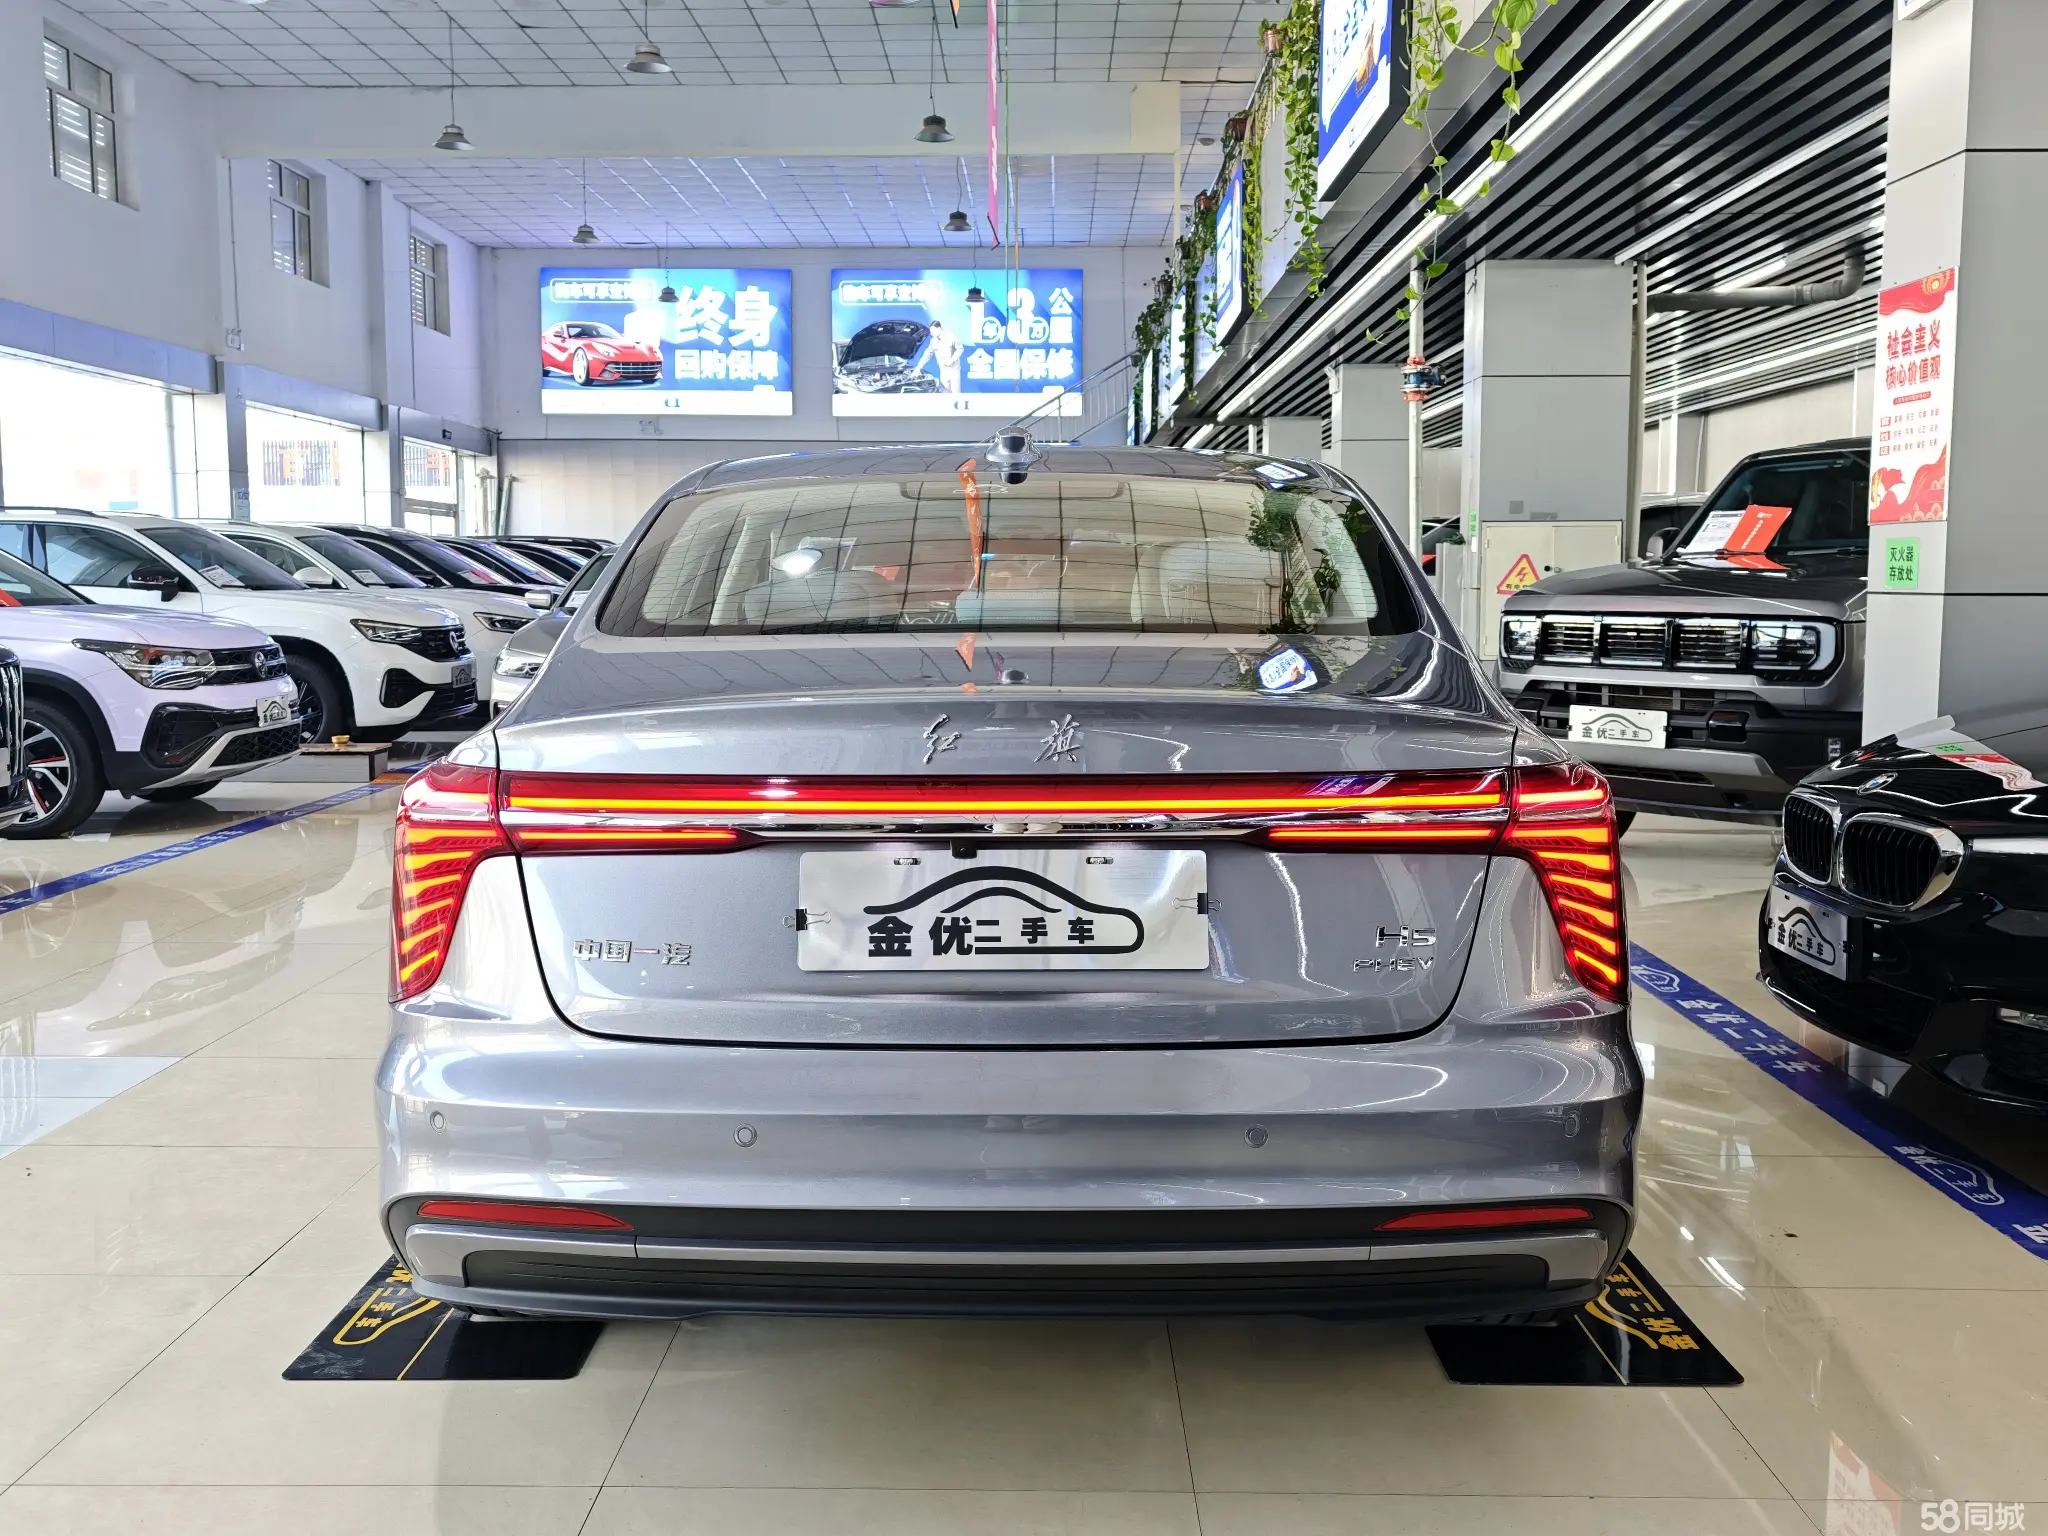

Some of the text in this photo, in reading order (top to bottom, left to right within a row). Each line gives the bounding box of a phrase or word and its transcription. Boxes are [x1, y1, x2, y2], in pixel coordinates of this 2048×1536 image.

[675, 285, 779, 347] 终身
[1886, 319, 1941, 361] 社会主义
[1885, 355, 1941, 390] 核心价值观
[1890, 545, 1914, 562] 灭火器
[1889, 565, 1914, 582] 存放处
[923, 713, 1082, 764] 红旗
[1581, 725, 1640, 739] 金优二手车
[572, 938, 692, 966] 中国一汽
[867, 915, 1095, 958] 金优二手车
[1375, 925, 1437, 948] H5
[1776, 922, 1825, 957] 金优二手车
[1353, 956, 1435, 972] PHEV
[1676, 999, 1824, 1073] 金优二手车
[356, 1263, 413, 1328] 优二手车
